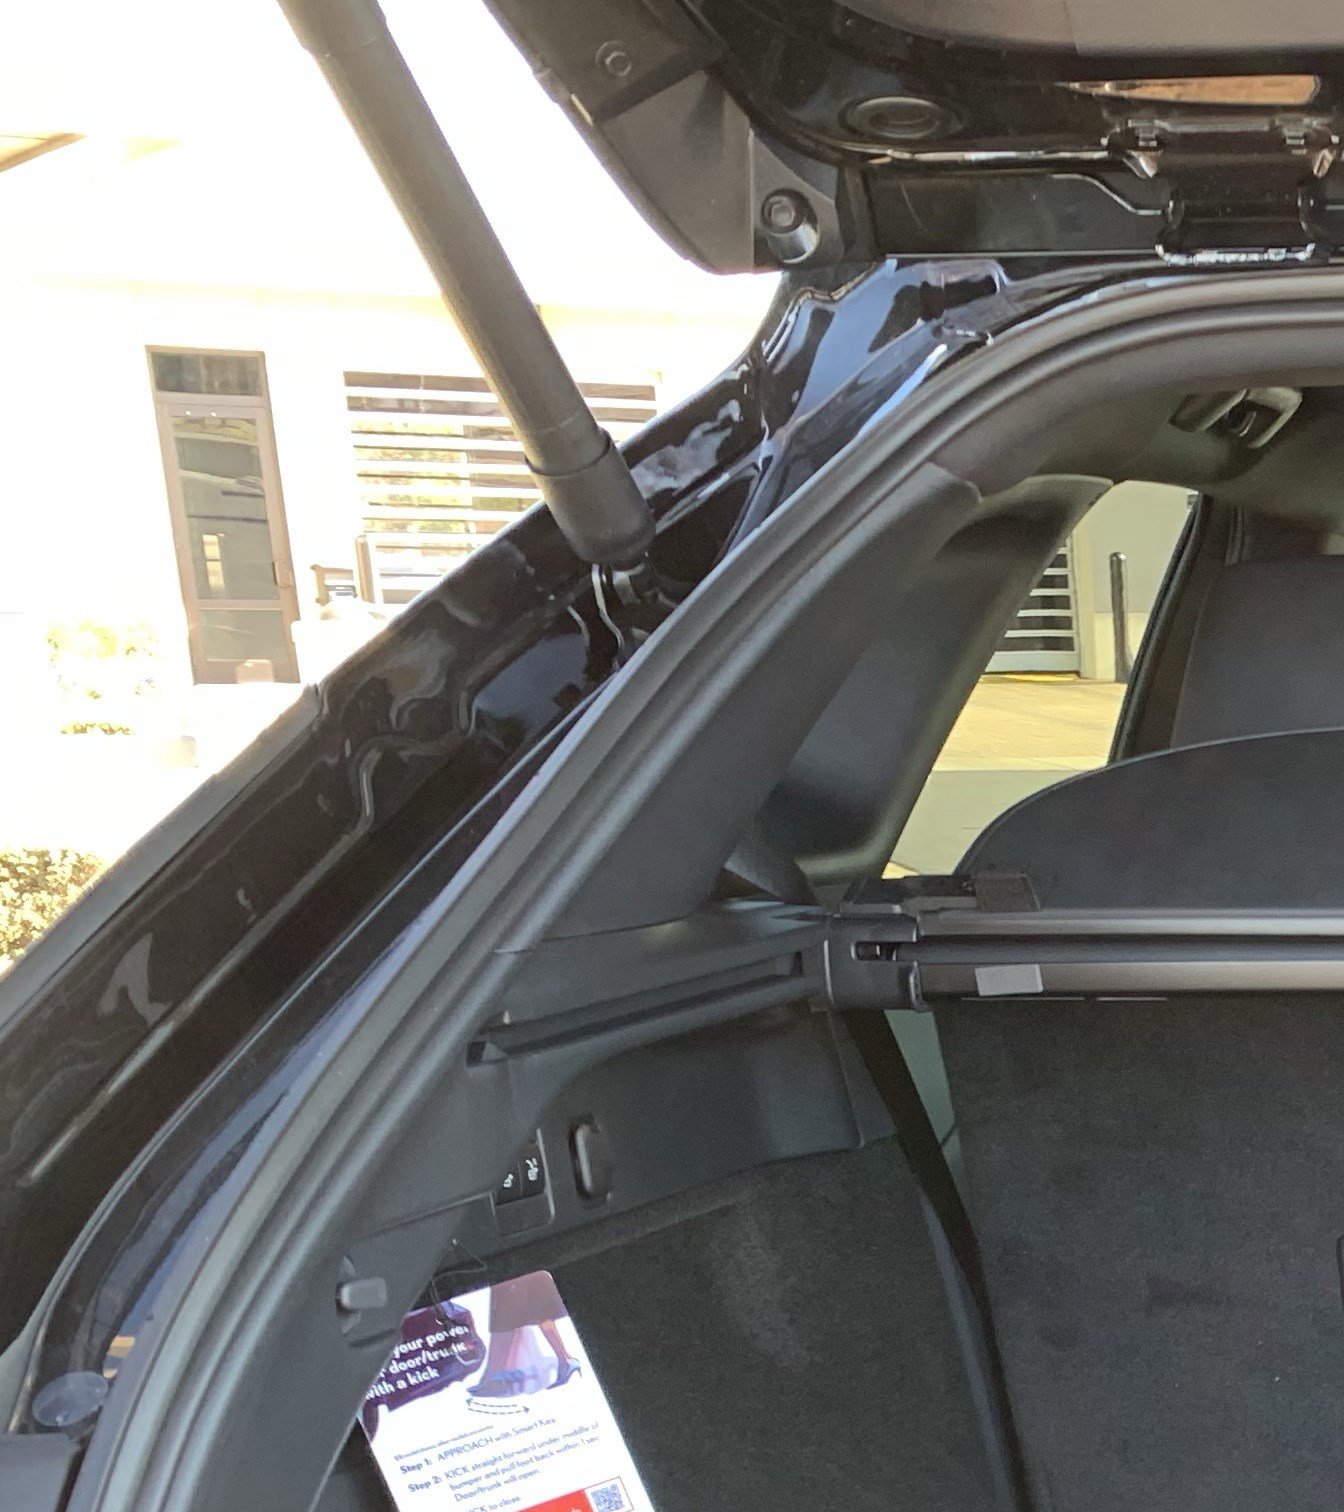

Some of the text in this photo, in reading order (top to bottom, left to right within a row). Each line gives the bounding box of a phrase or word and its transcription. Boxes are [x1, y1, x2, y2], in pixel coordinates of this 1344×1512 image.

[392, 1338, 423, 1358] your
[396, 1379, 407, 1389] a
[406, 1365, 439, 1385] kick
[399, 1462, 422, 1474] Step
[437, 1436, 493, 1460] APPROACH
[407, 1481, 431, 1492] Step
[444, 1465, 470, 1479] KICK
